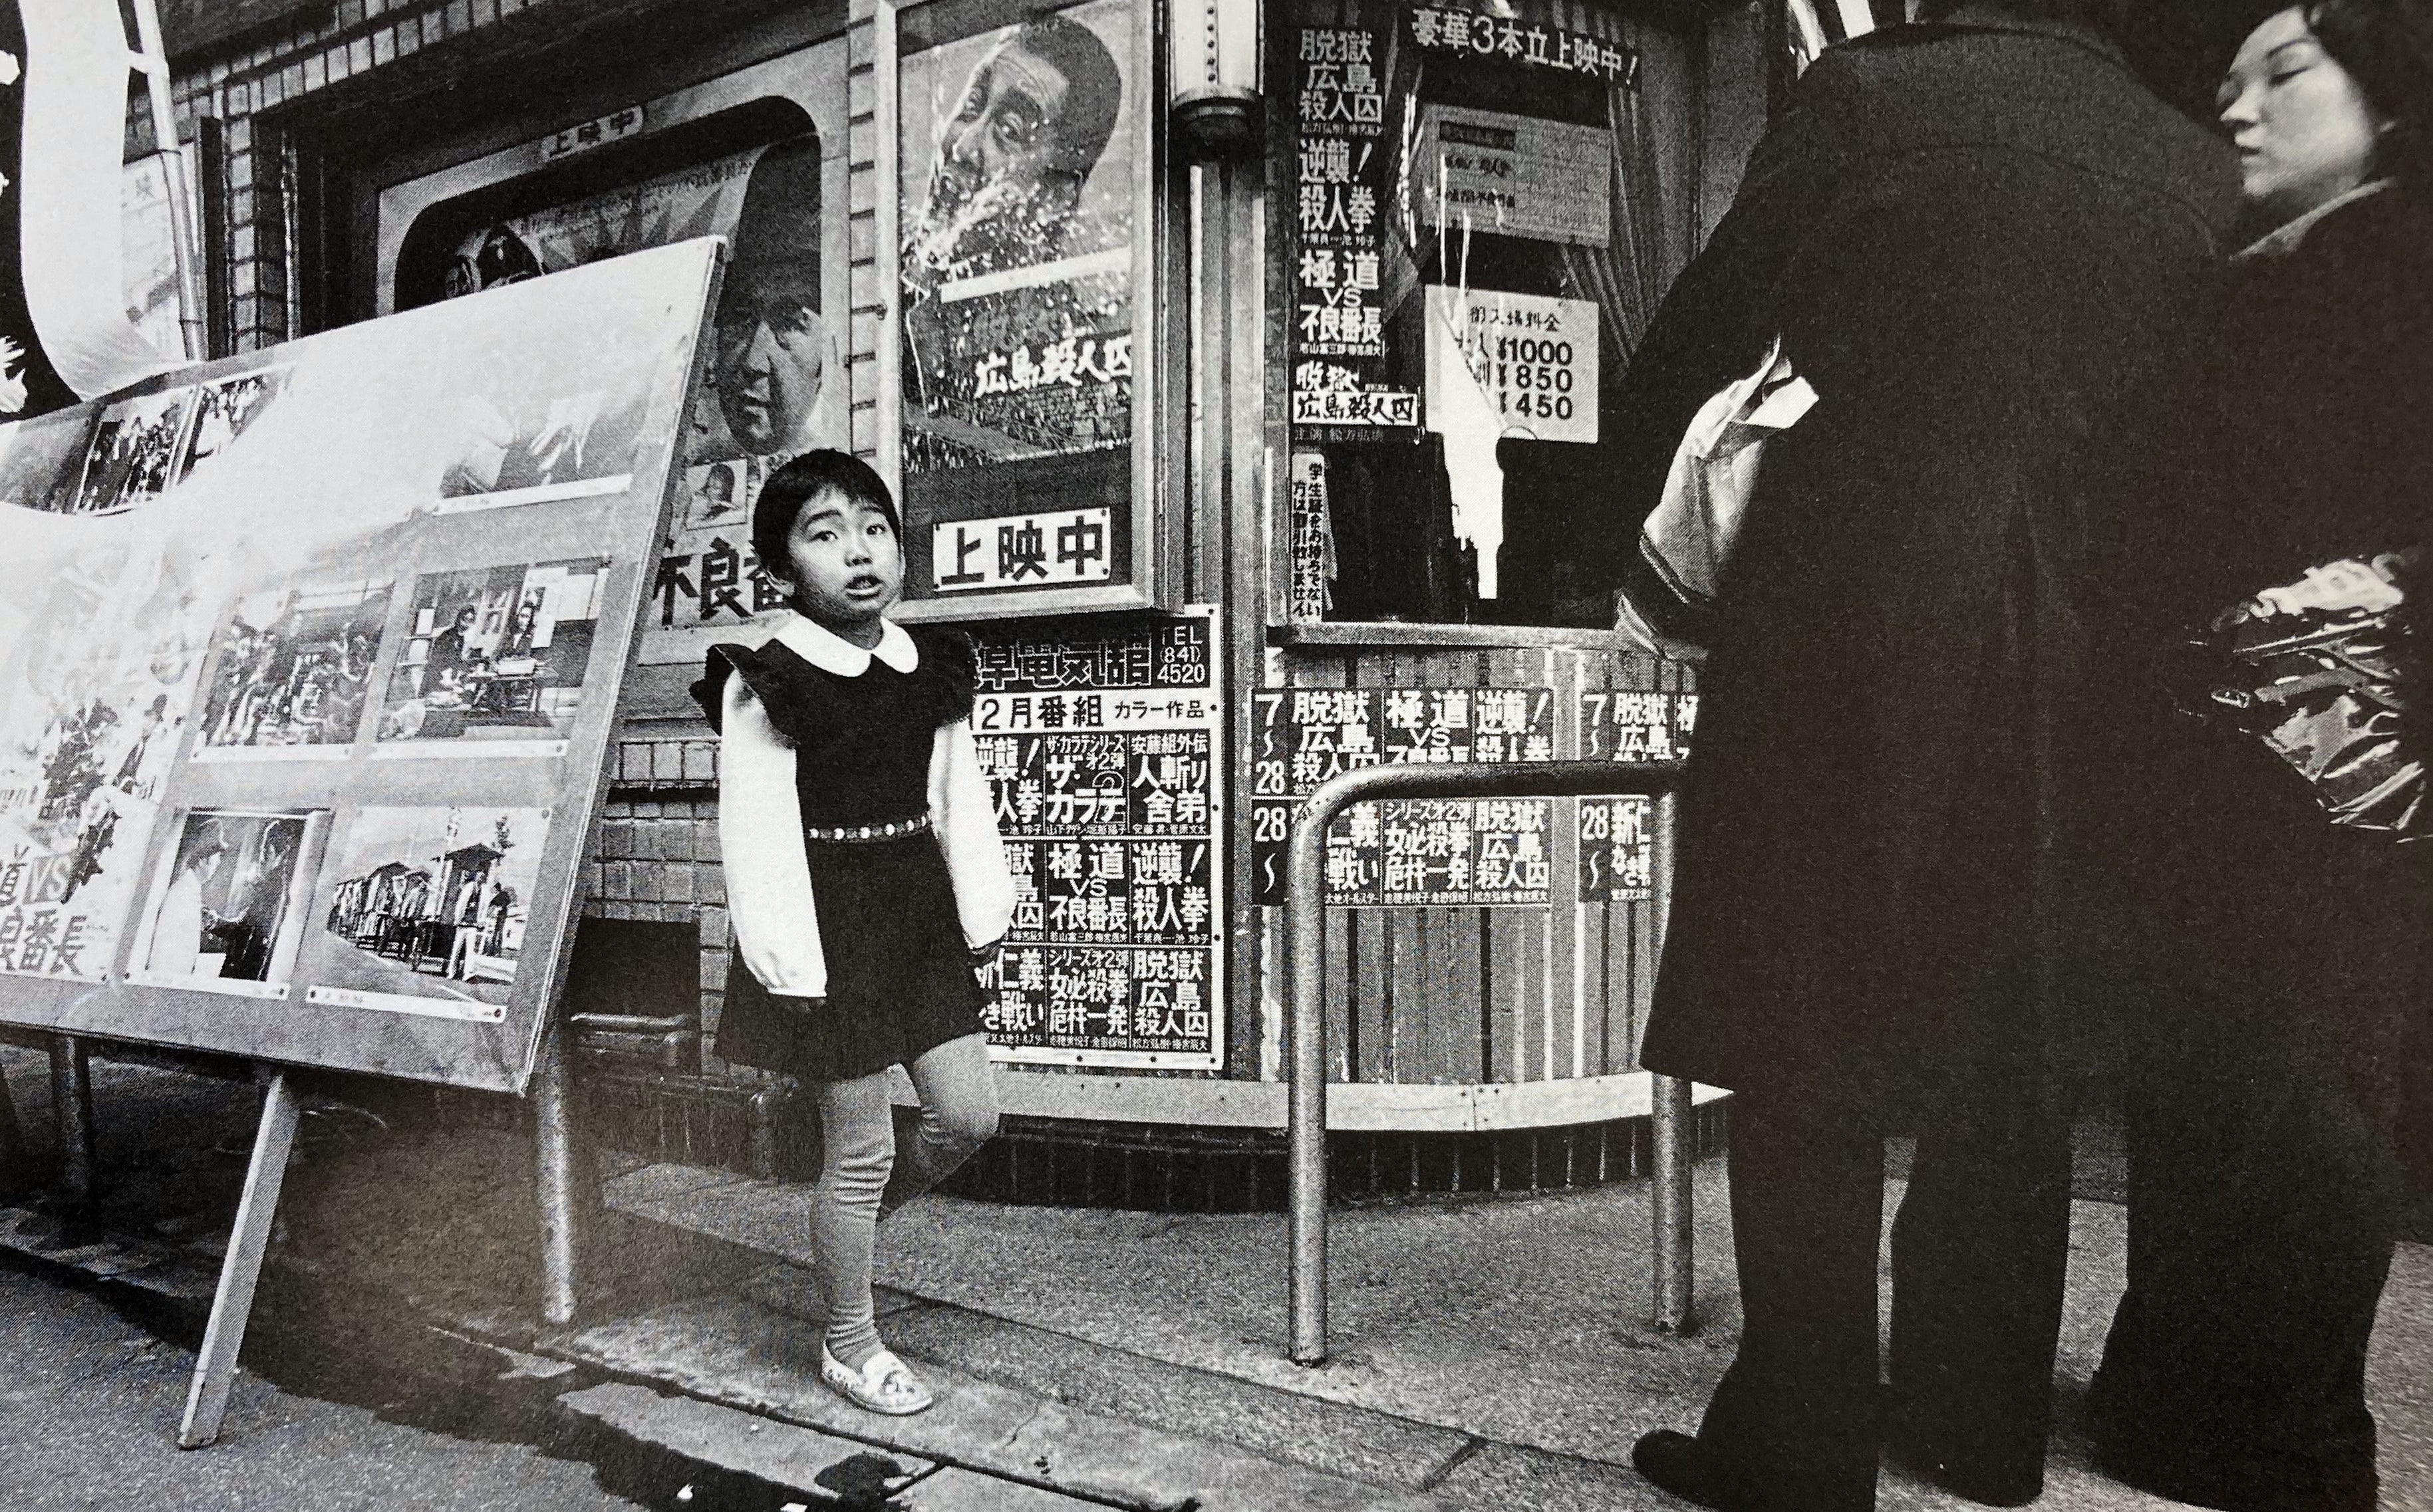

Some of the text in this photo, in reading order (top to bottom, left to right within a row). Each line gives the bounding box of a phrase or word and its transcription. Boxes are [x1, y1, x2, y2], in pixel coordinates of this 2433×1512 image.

[1299, 29, 1373, 63] 脱獄
[1411, 7, 1638, 84] 豪華3本立上映中!
[1306, 63, 1377, 94] 広島
[1299, 91, 1383, 124] 殺人囚
[1300, 138, 1372, 184] 逆襲!
[1299, 186, 1375, 233] 殺人拳
[1299, 248, 1379, 289] 極道
[1323, 289, 1362, 307] VS
[1299, 305, 1383, 343] 不良番長
[1296, 360, 1360, 394] 脱獄
[1297, 393, 1413, 425] 広島殺人囚
[940, 515, 1103, 586] 上映中
[1157, 664, 1205, 684] 4520
[981, 695, 1205, 729] 2月番組 カラー作品
[1292, 691, 1370, 724] 脱獄
[1386, 690, 1469, 728] 極道
[1475, 690, 1549, 733] 逆襲!
[1613, 692, 1668, 725] 脱獄
[1131, 735, 1207, 756] 安藤組外伝
[1300, 723, 1375, 753] 広島
[1409, 727, 1451, 746] VS
[1618, 726, 1671, 755] 広島
[1133, 757, 1205, 789] 人斬り
[990, 779, 1042, 824] 人拳
[1046, 789, 1126, 824] カラテ
[1142, 789, 1207, 823] 舎弟
[1475, 801, 1546, 832] 脱獄
[1385, 821, 1471, 858] 女必殺拳
[1481, 832, 1543, 862] 広島
[1048, 843, 1125, 880] 極道
[1132, 843, 1205, 885] 逆襲!
[1475, 860, 1550, 890] 殺人囚
[1069, 878, 1107, 897] VS
[1049, 896, 1127, 931] 不良番長
[1132, 886, 1209, 932] 殺人拳
[1133, 949, 1203, 981] 脱獄
[1049, 967, 1129, 1005] 女必殺拳
[1139, 981, 1201, 1011] 広島
[1135, 1008, 1208, 1038] 殺人囚
